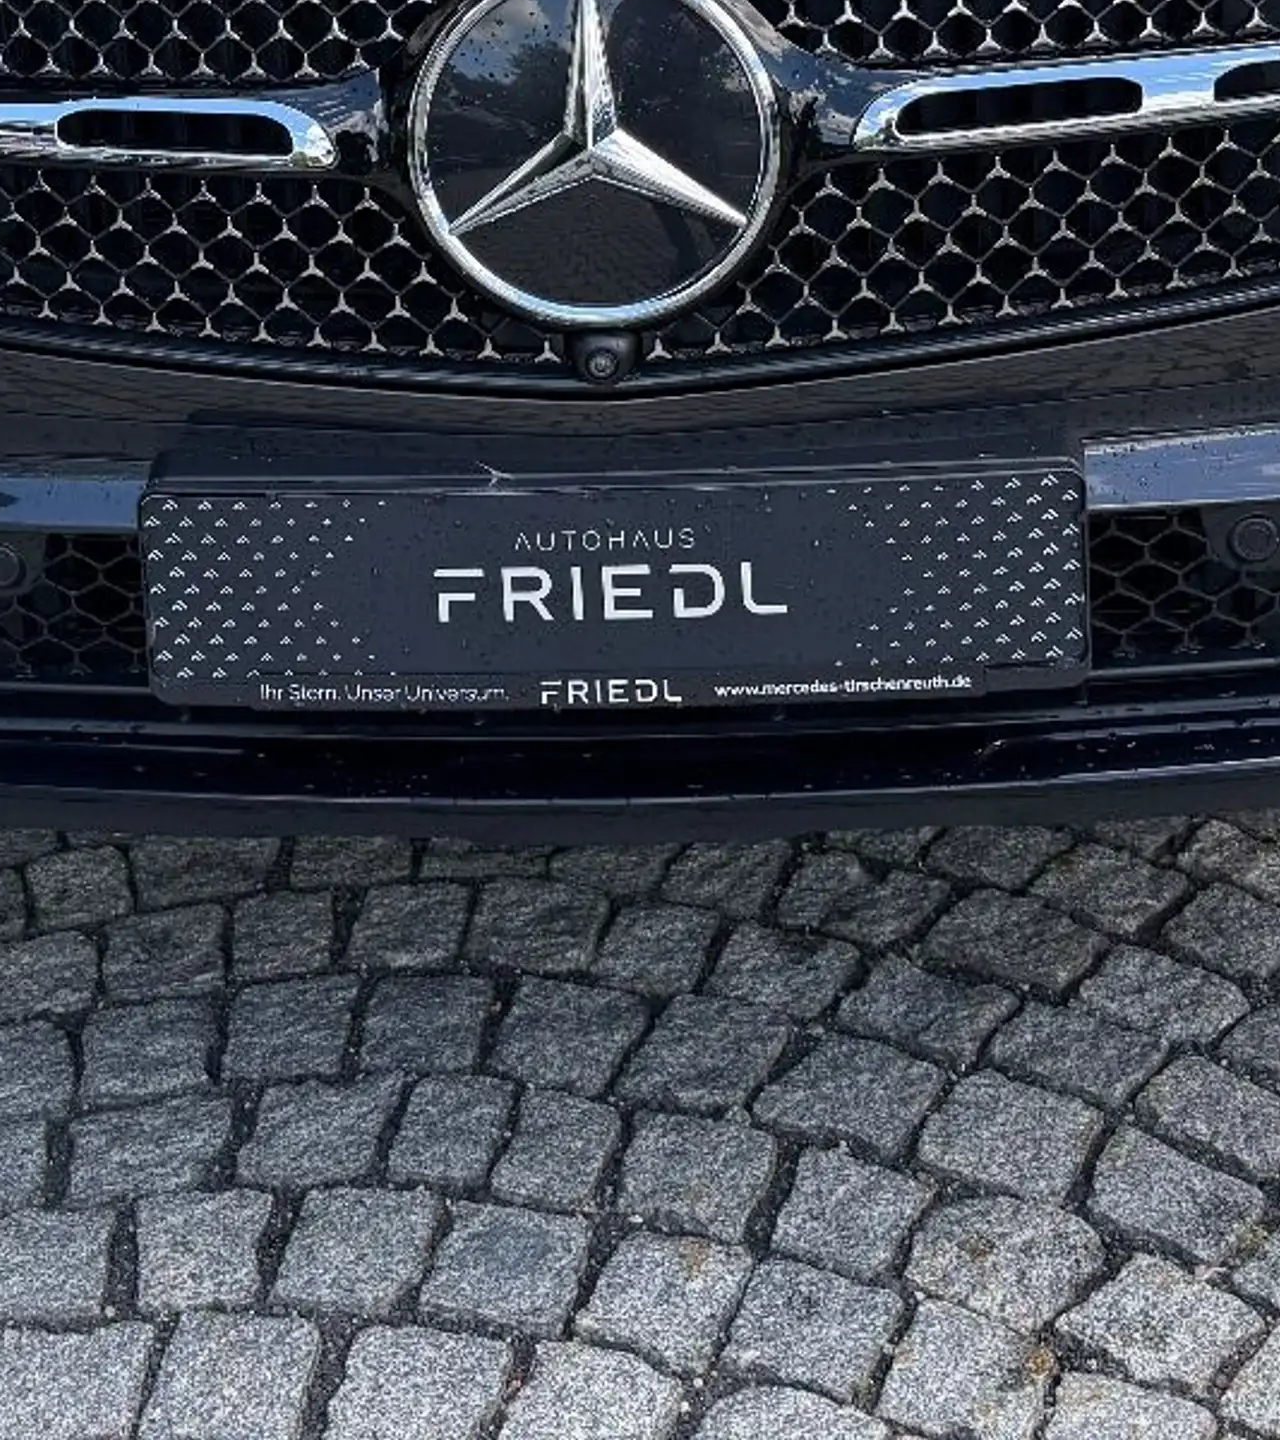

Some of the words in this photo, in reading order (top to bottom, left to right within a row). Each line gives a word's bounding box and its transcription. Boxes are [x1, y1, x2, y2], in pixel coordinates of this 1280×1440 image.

[514, 527, 697, 552] AUTOHAUS
[433, 561, 788, 623] FRIEDL
[260, 683, 283, 701] Ihr
[539, 679, 682, 705] FRIEDL
